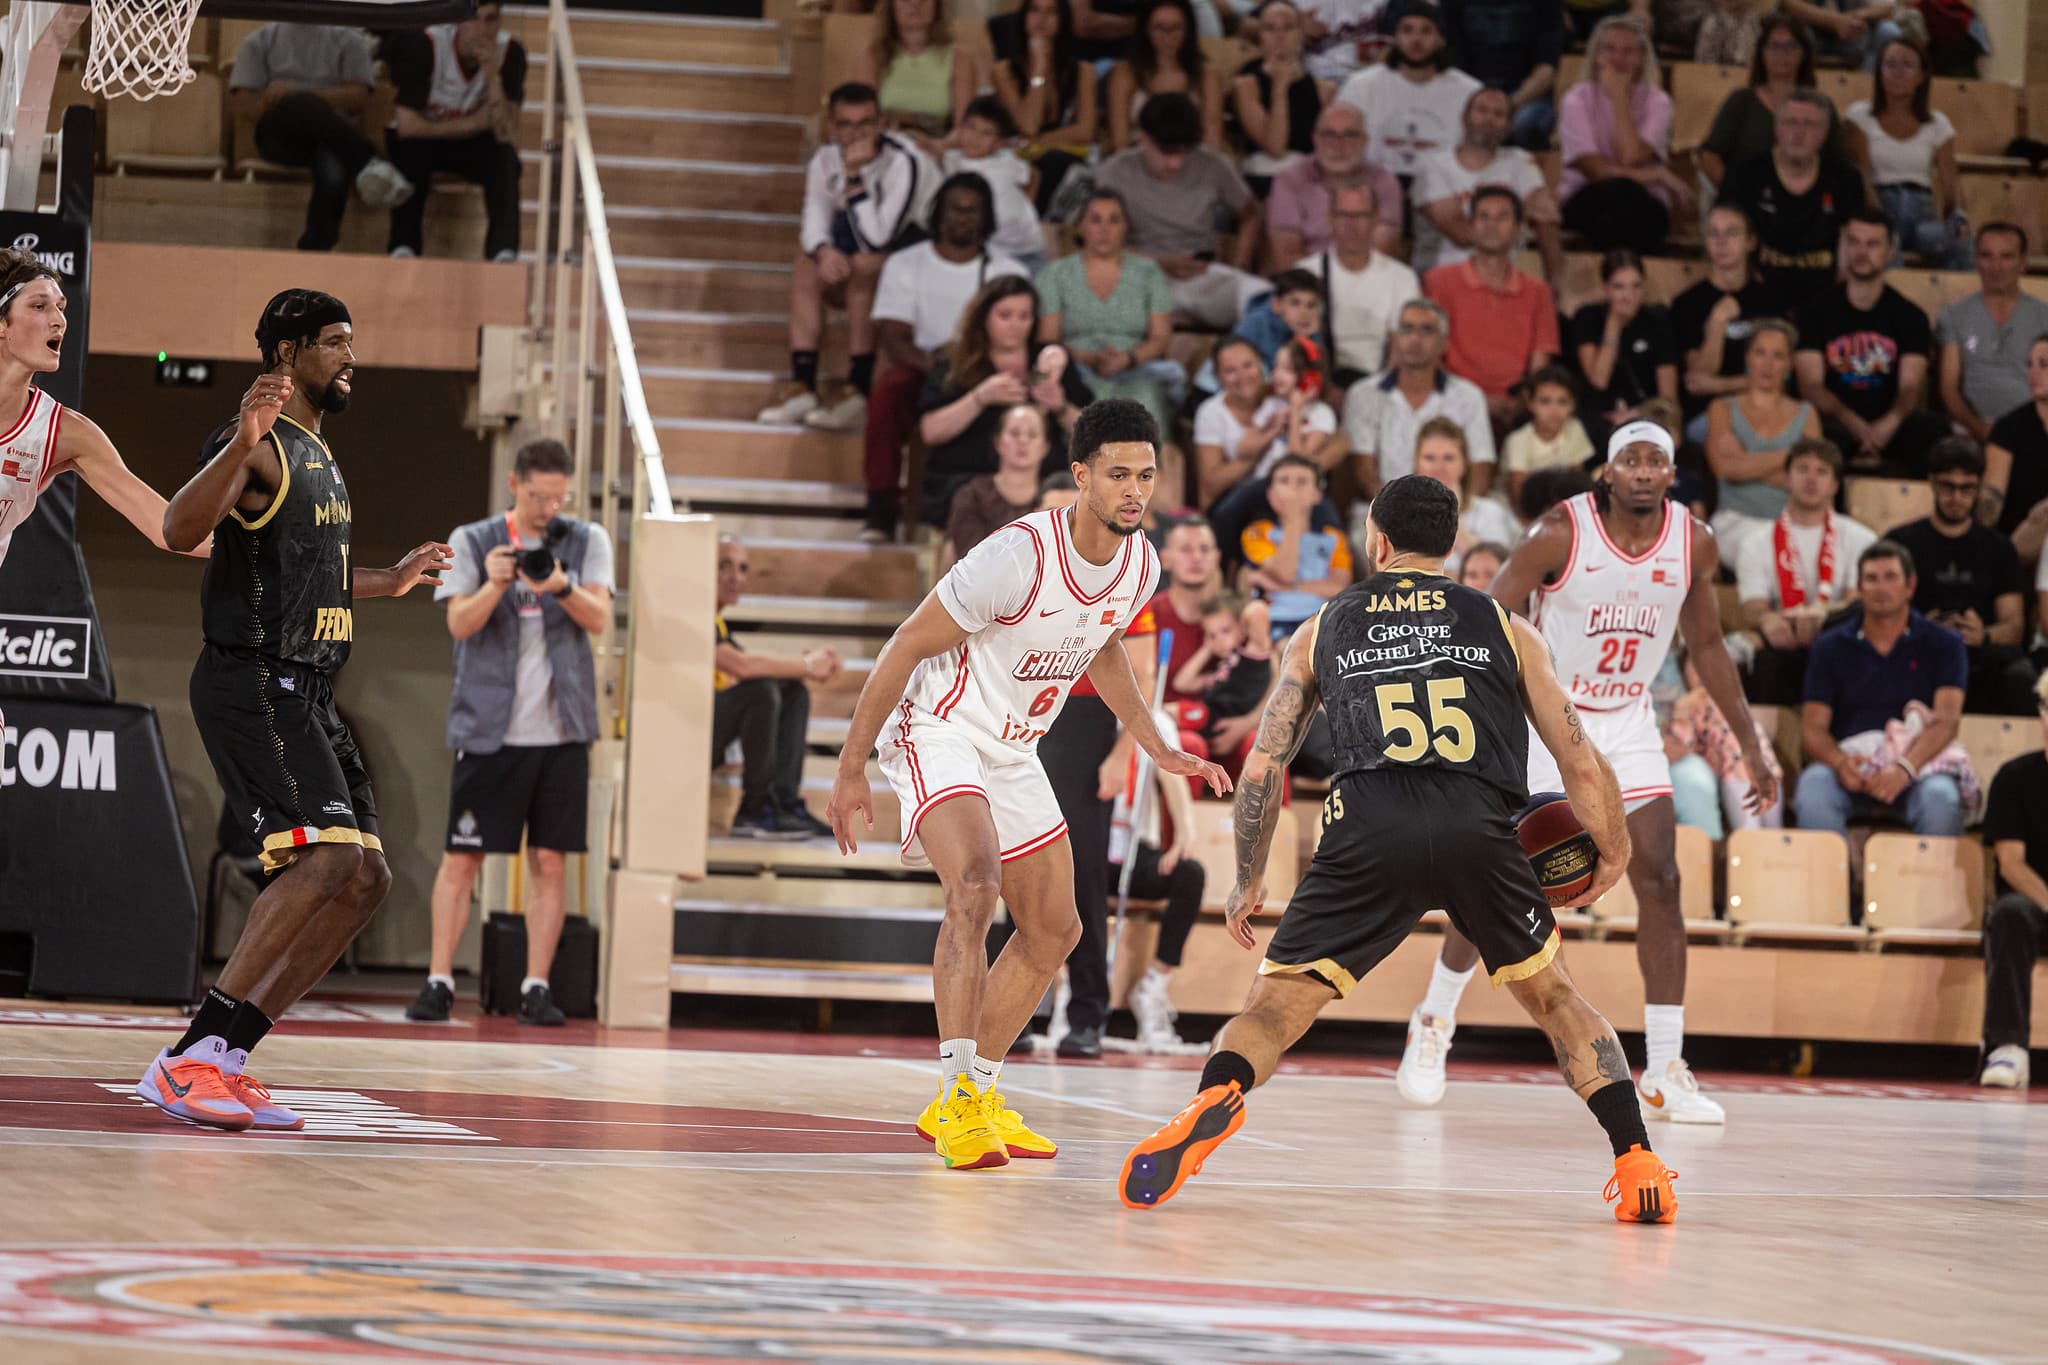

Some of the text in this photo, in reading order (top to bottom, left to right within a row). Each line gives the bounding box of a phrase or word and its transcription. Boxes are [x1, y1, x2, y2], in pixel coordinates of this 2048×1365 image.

[1365, 591, 1447, 613] JAMES
[1584, 603, 1663, 637] CHALON
[1061, 636, 1087, 649] ELAN
[1597, 638, 1640, 674] 25
[1028, 686, 1060, 717] 6
[1571, 675, 1644, 697] ixina
[1375, 677, 1476, 763] 55
[1324, 788, 1345, 825] 55
